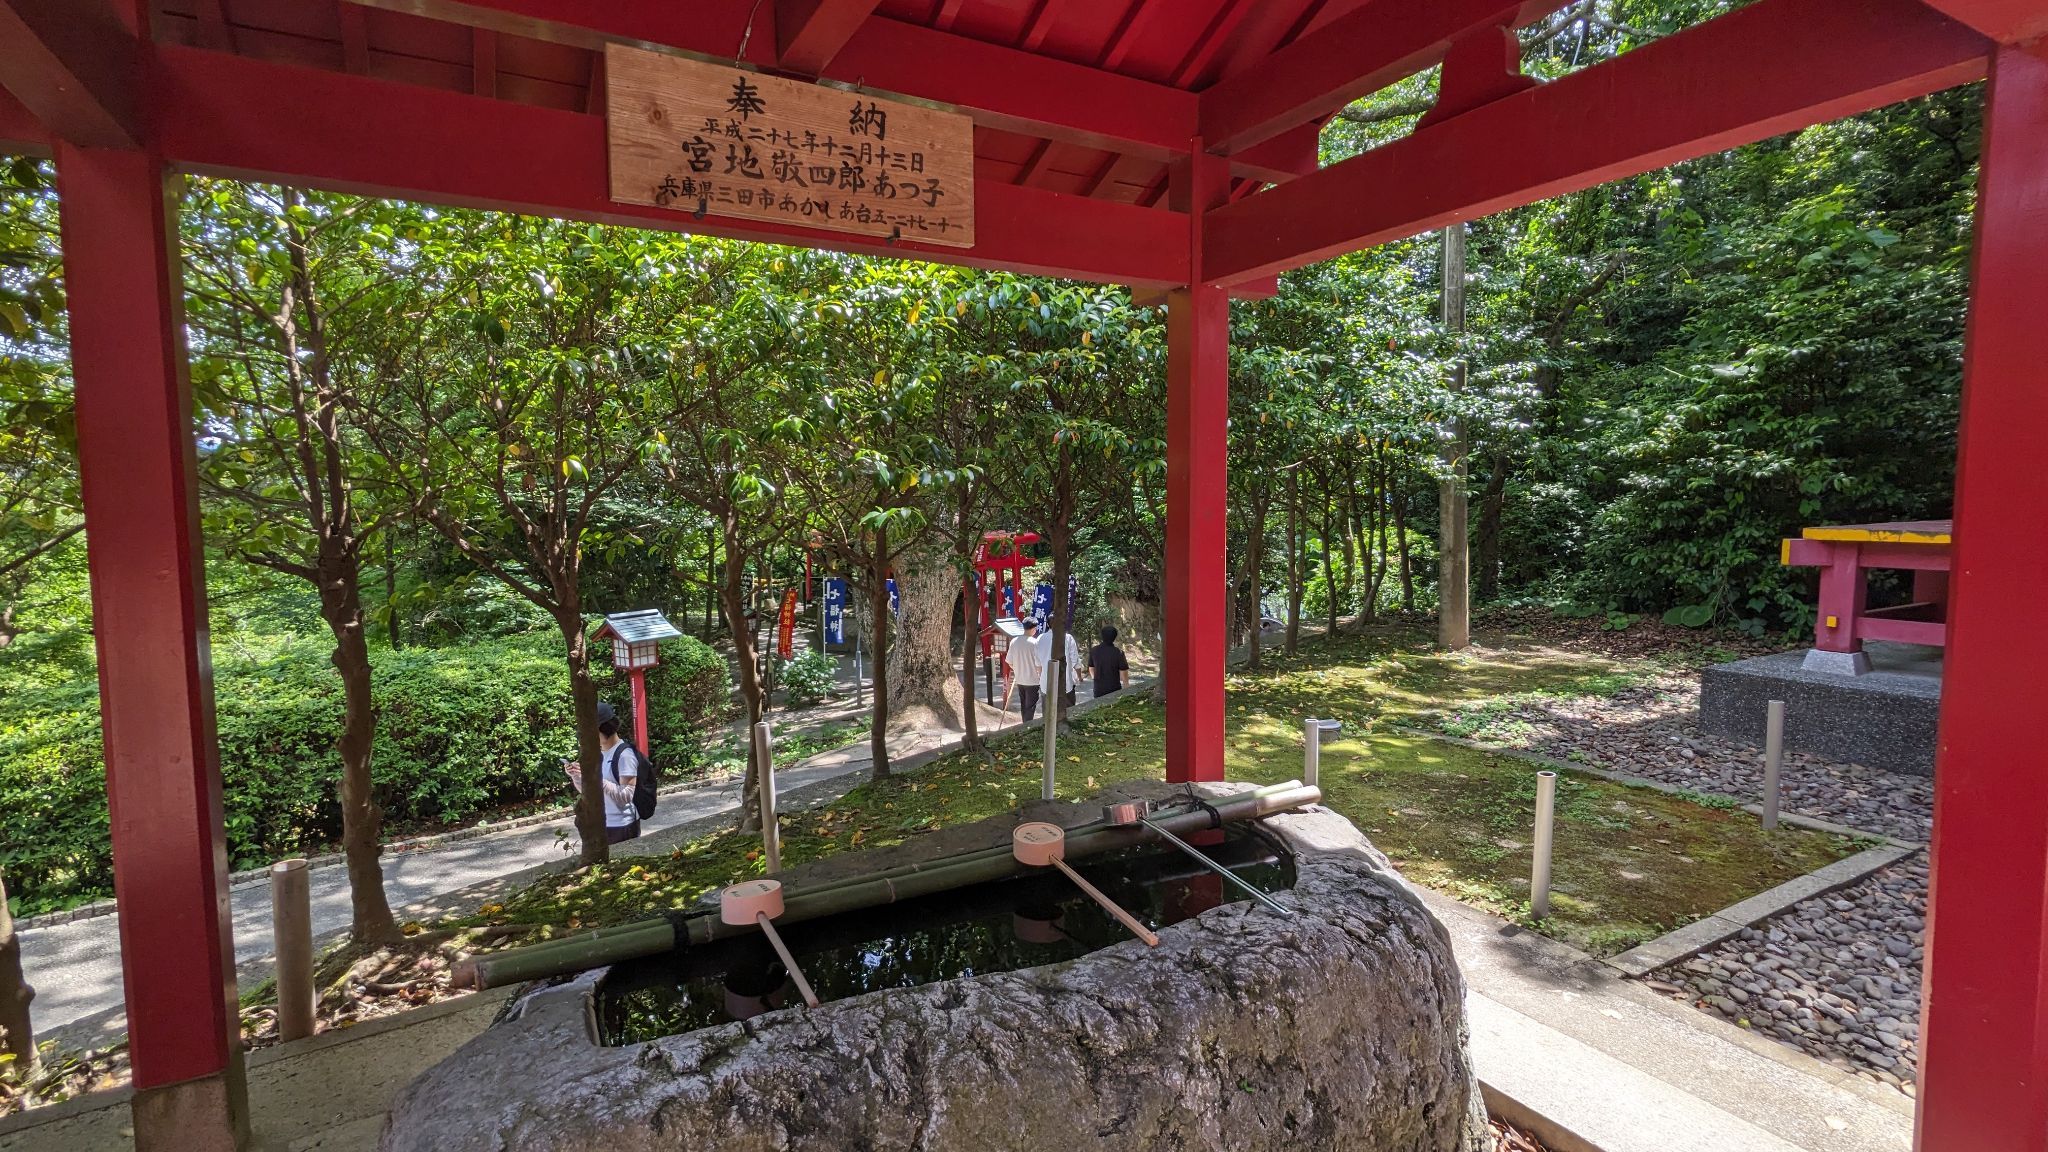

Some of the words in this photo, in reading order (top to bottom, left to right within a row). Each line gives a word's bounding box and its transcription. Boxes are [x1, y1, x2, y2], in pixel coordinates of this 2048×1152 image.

[700, 118, 924, 174] 平成二十七年十二月十三日
